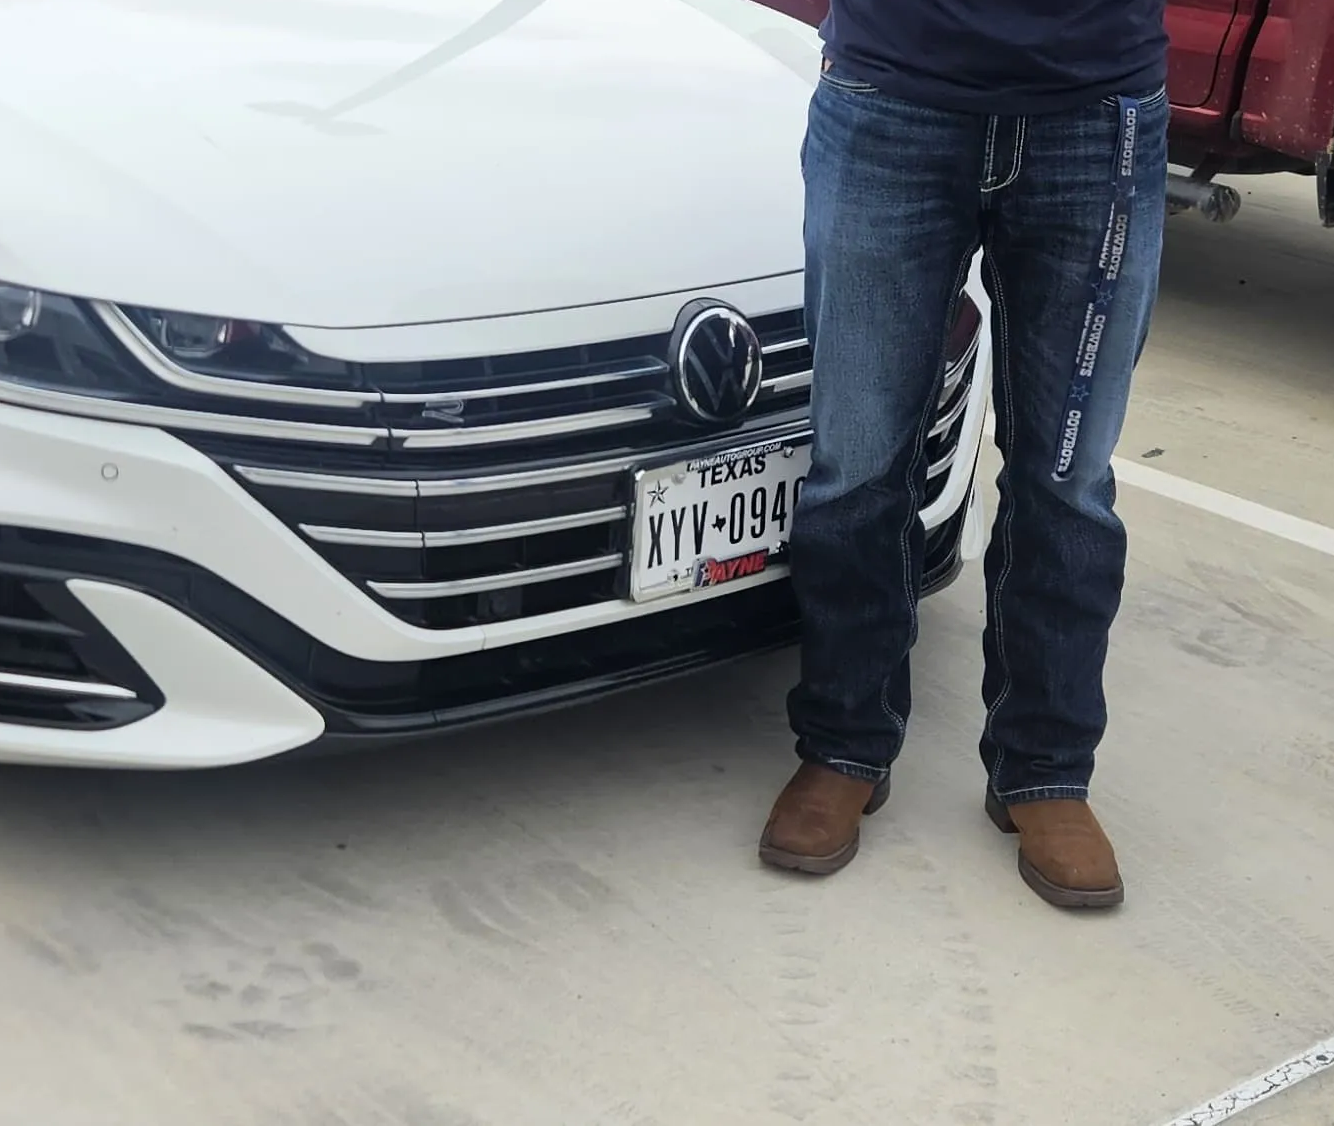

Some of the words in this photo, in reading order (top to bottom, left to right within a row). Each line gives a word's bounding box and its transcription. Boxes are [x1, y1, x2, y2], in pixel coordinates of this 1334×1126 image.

[1121, 107, 1137, 177] COWBOYS
[1107, 214, 1128, 281] COWBOYS
[1079, 314, 1106, 377] COWBOYS
[698, 454, 767, 489] TEXAS
[1057, 409, 1082, 473] COWBOYS
[647, 500, 709, 569] XYV
[694, 551, 767, 589] PAYNE
